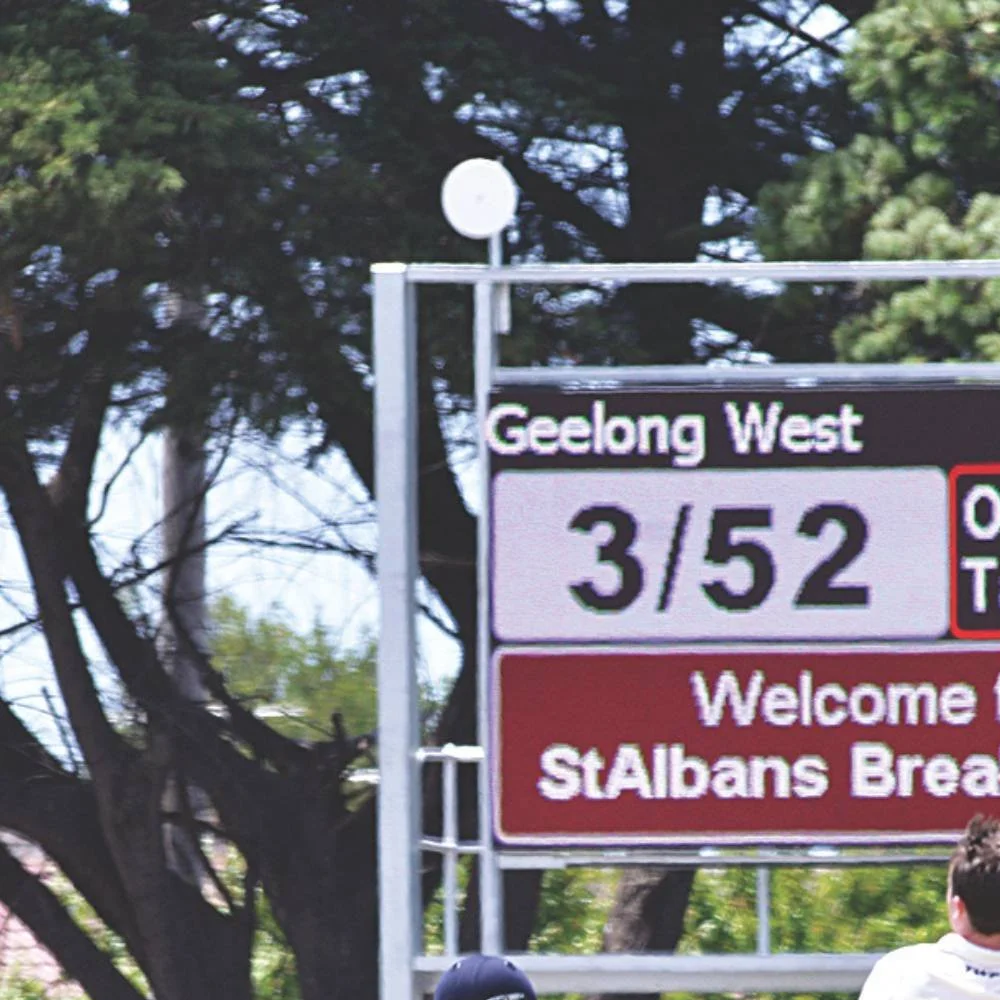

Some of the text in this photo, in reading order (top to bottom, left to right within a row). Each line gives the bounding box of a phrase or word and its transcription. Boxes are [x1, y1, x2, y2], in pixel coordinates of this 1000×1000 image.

[486, 402, 863, 467] Geelong West
[567, 502, 871, 613] 3/52
[689, 672, 977, 728] Welcome
[537, 746, 829, 802] StAlbans
